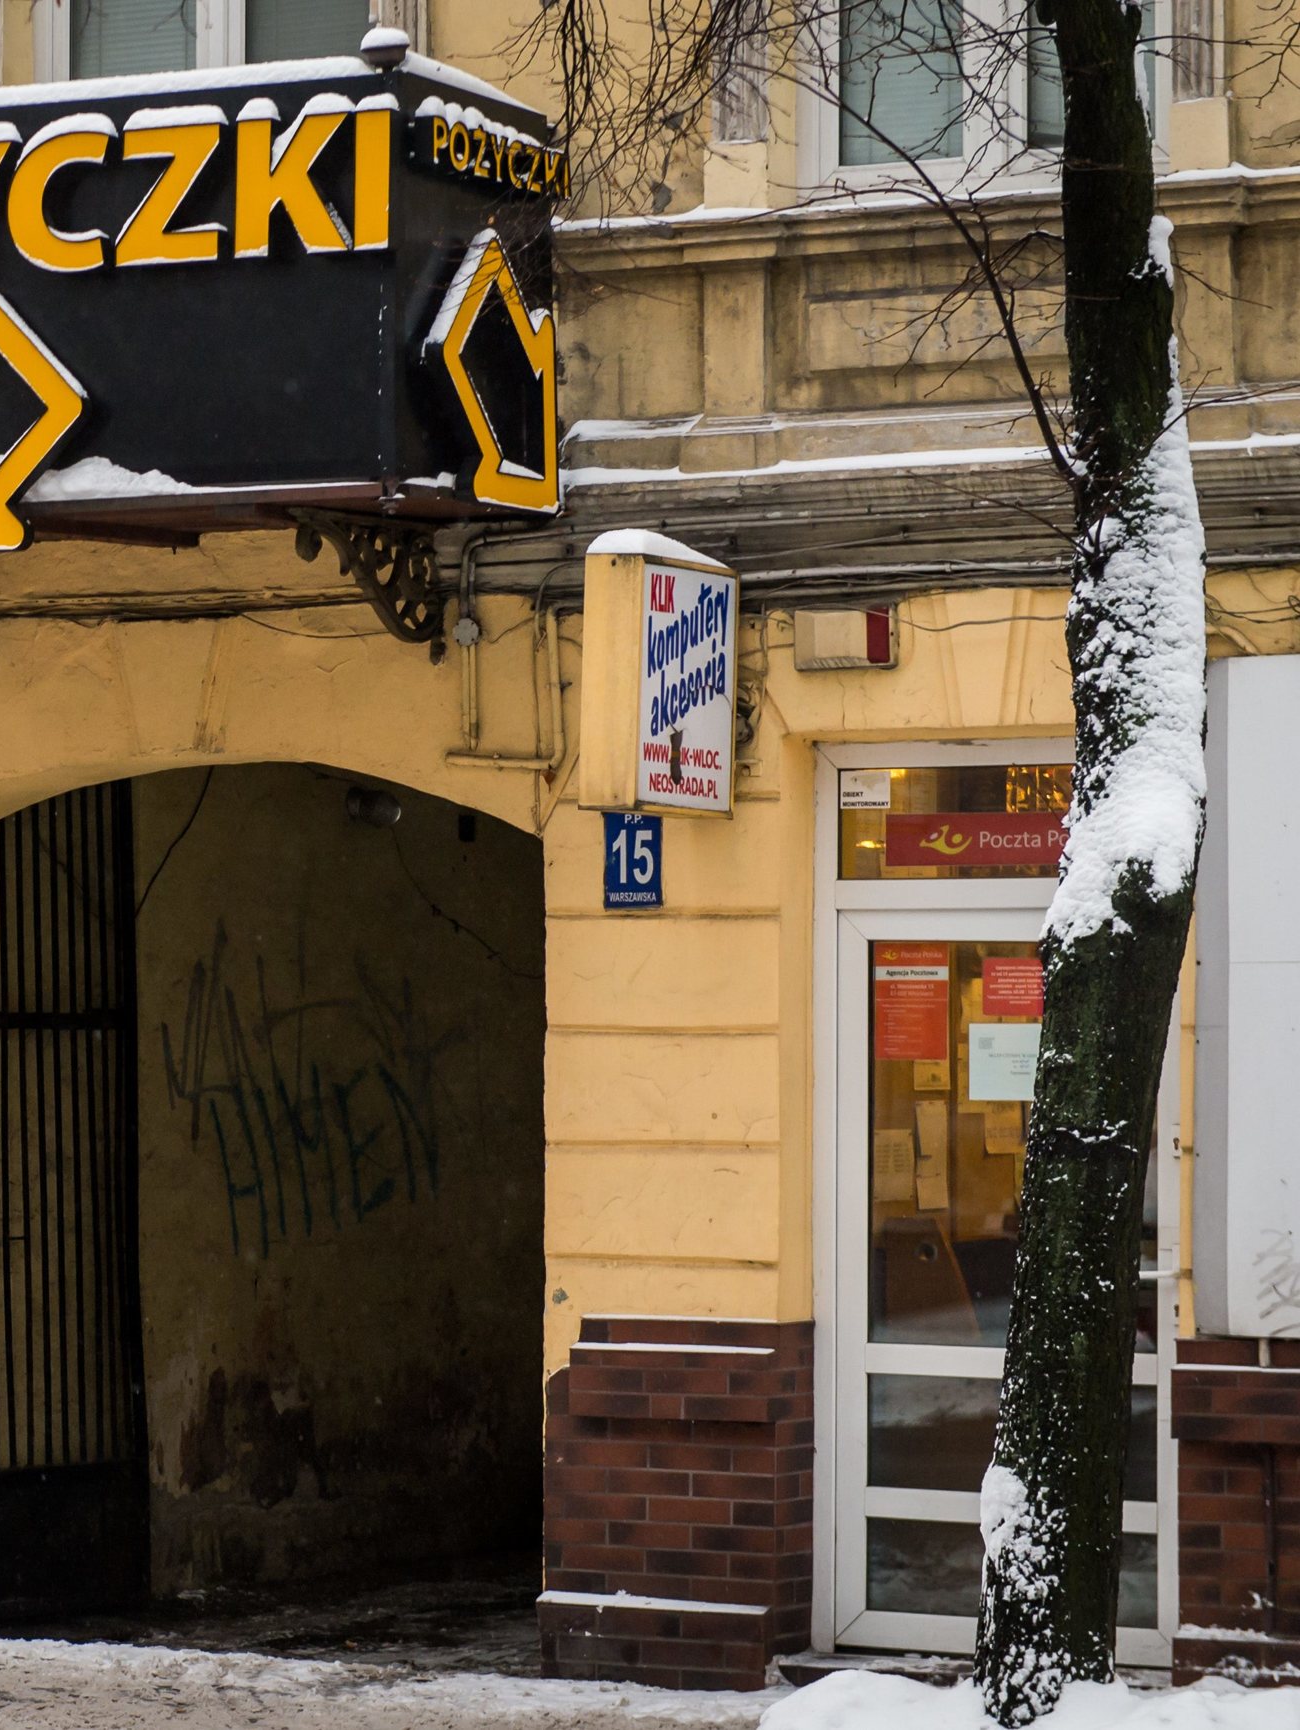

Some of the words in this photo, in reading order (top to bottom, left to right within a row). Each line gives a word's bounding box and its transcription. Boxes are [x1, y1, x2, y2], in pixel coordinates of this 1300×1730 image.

[433, 115, 572, 200] POŻYCZKI
[651, 572, 676, 614] KLIK
[648, 582, 730, 678] komputery
[650, 637, 726, 736] akcesoria
[612, 829, 654, 885] 15
[979, 831, 1041, 849] Poczta
[608, 891, 657, 903] WARSZAWSKA
[886, 969, 909, 977] Agencja
[910, 969, 939, 977] Pocztowa
